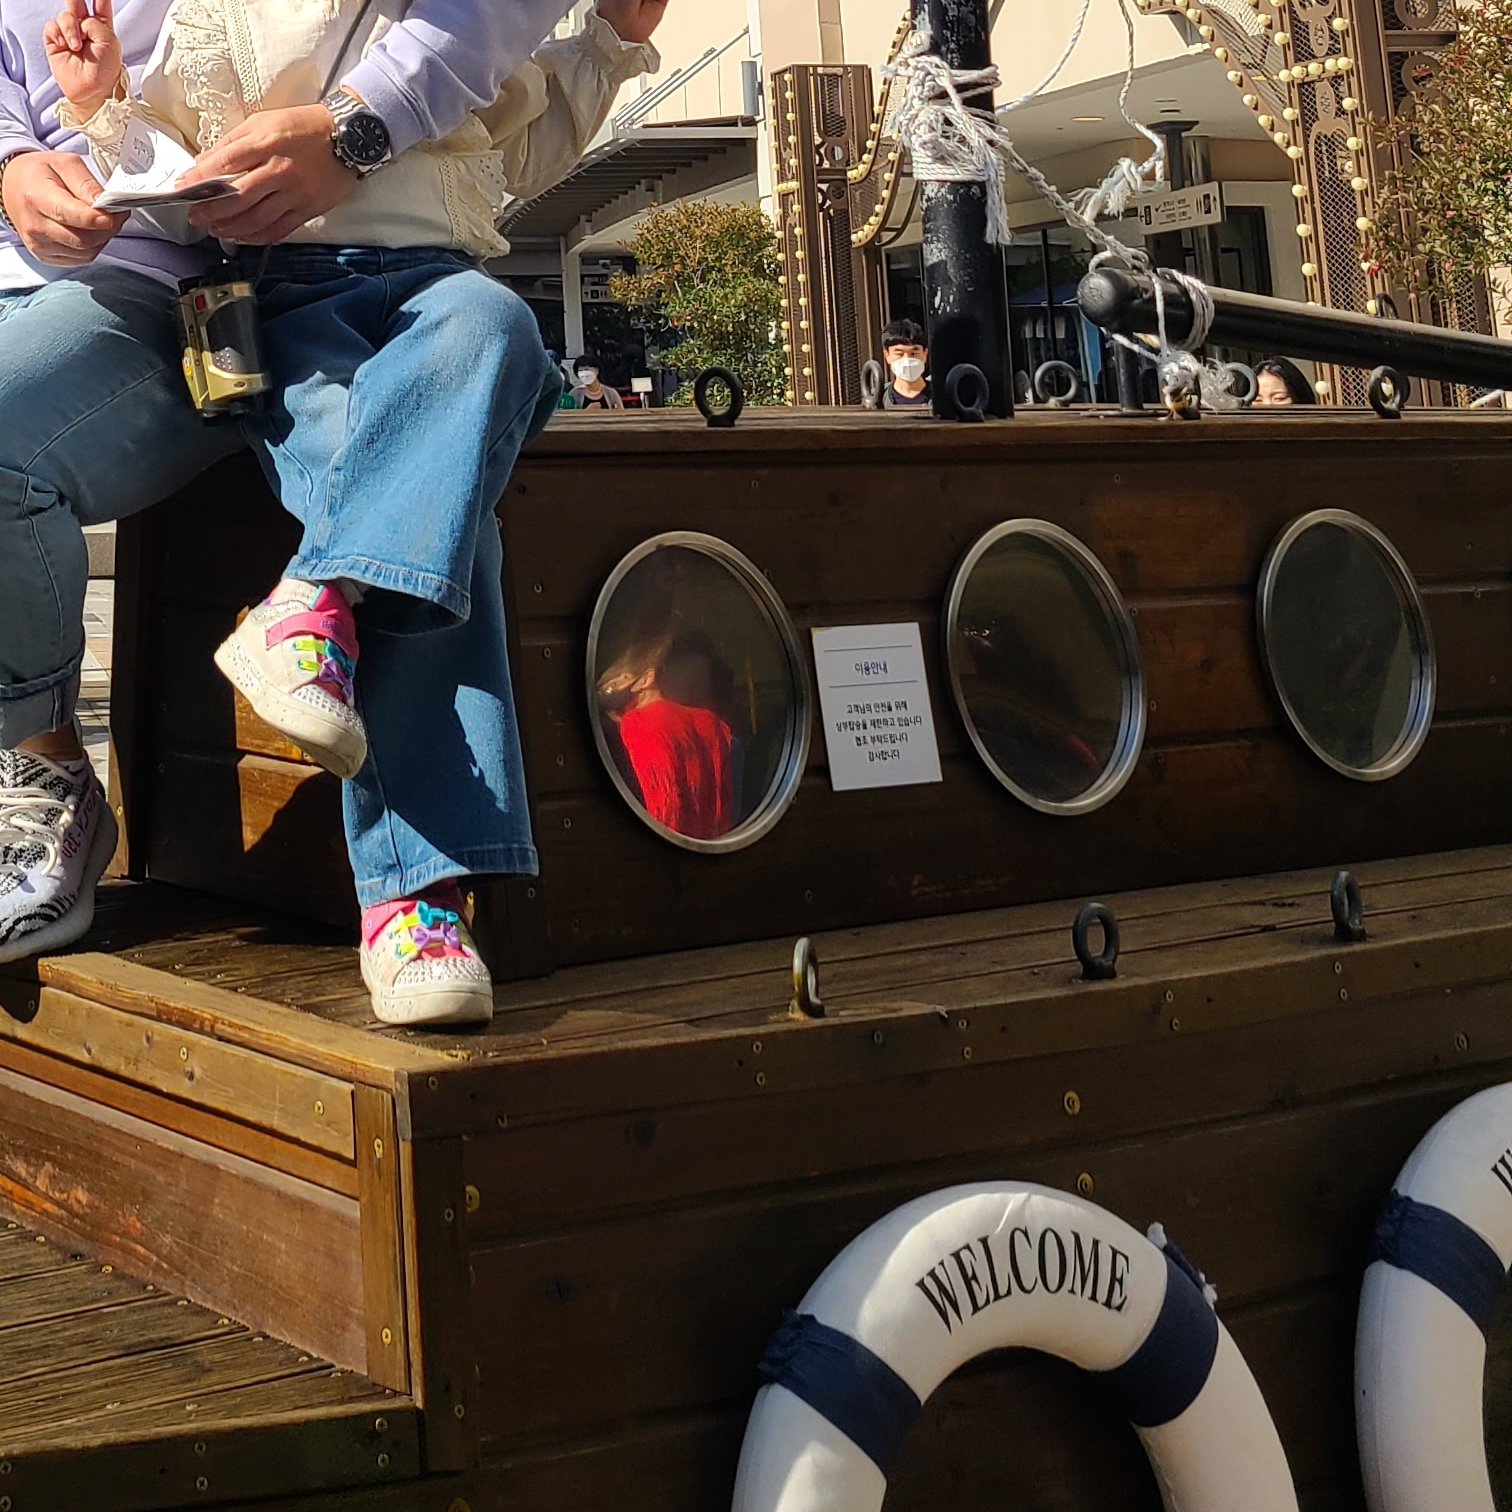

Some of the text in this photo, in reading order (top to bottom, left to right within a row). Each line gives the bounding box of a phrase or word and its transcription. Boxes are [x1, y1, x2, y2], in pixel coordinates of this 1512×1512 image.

[854, 660, 888, 676] 이용안내
[846, 700, 908, 715] 고객님의 안전을 위해
[870, 717, 896, 729] 제한하고
[897, 715, 923, 727] 있습니다
[869, 733, 908, 745] 부탁드립니다
[868, 749, 900, 762] 감사합니다
[914, 1225, 1131, 1336] WELCOME
